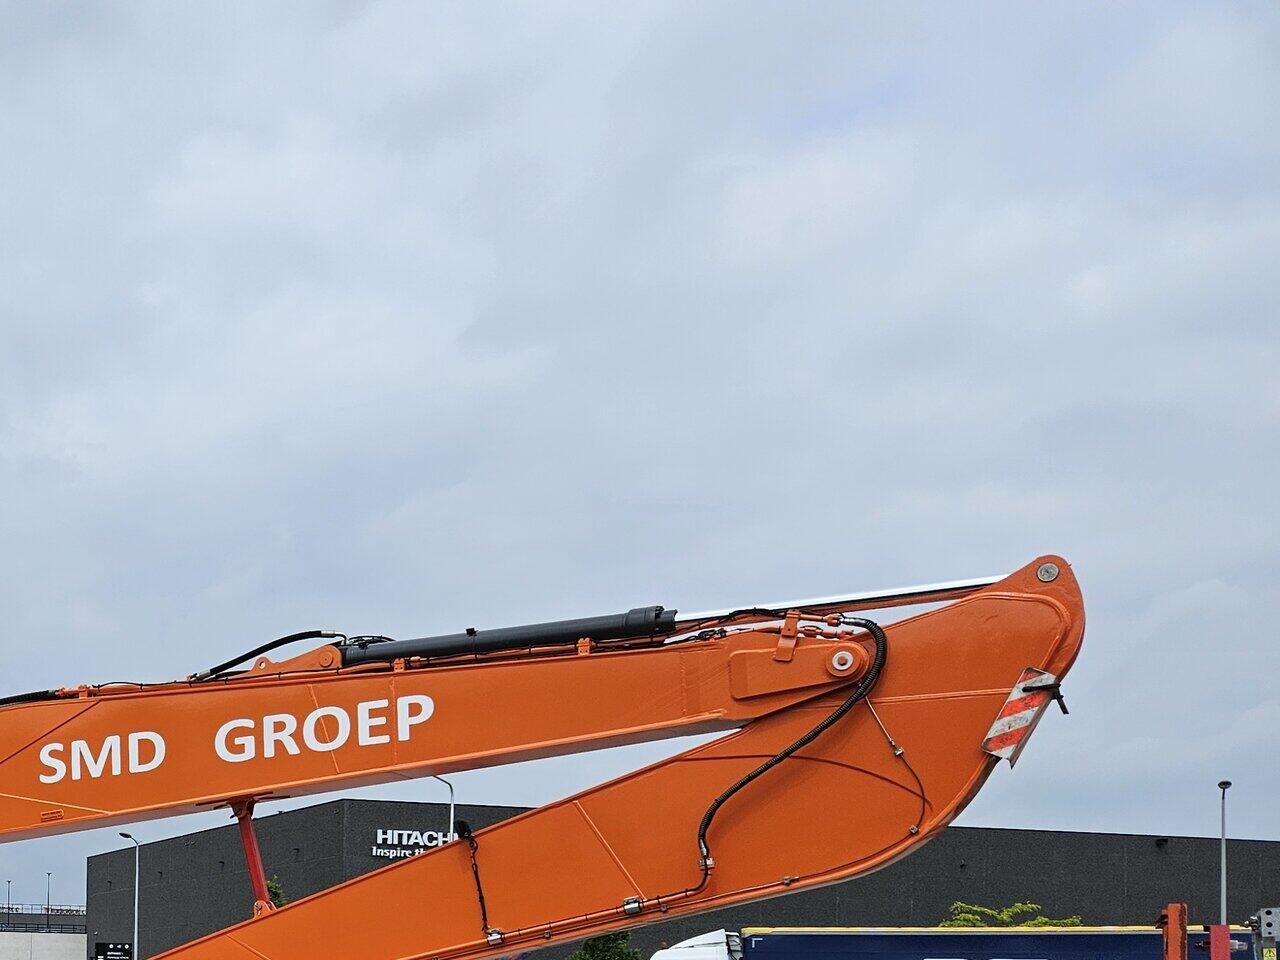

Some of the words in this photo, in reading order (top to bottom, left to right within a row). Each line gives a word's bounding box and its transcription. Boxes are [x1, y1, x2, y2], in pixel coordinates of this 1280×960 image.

[39, 731, 166, 784] SMD
[214, 694, 434, 763] GROEP
[371, 846, 413, 859] Inspire
